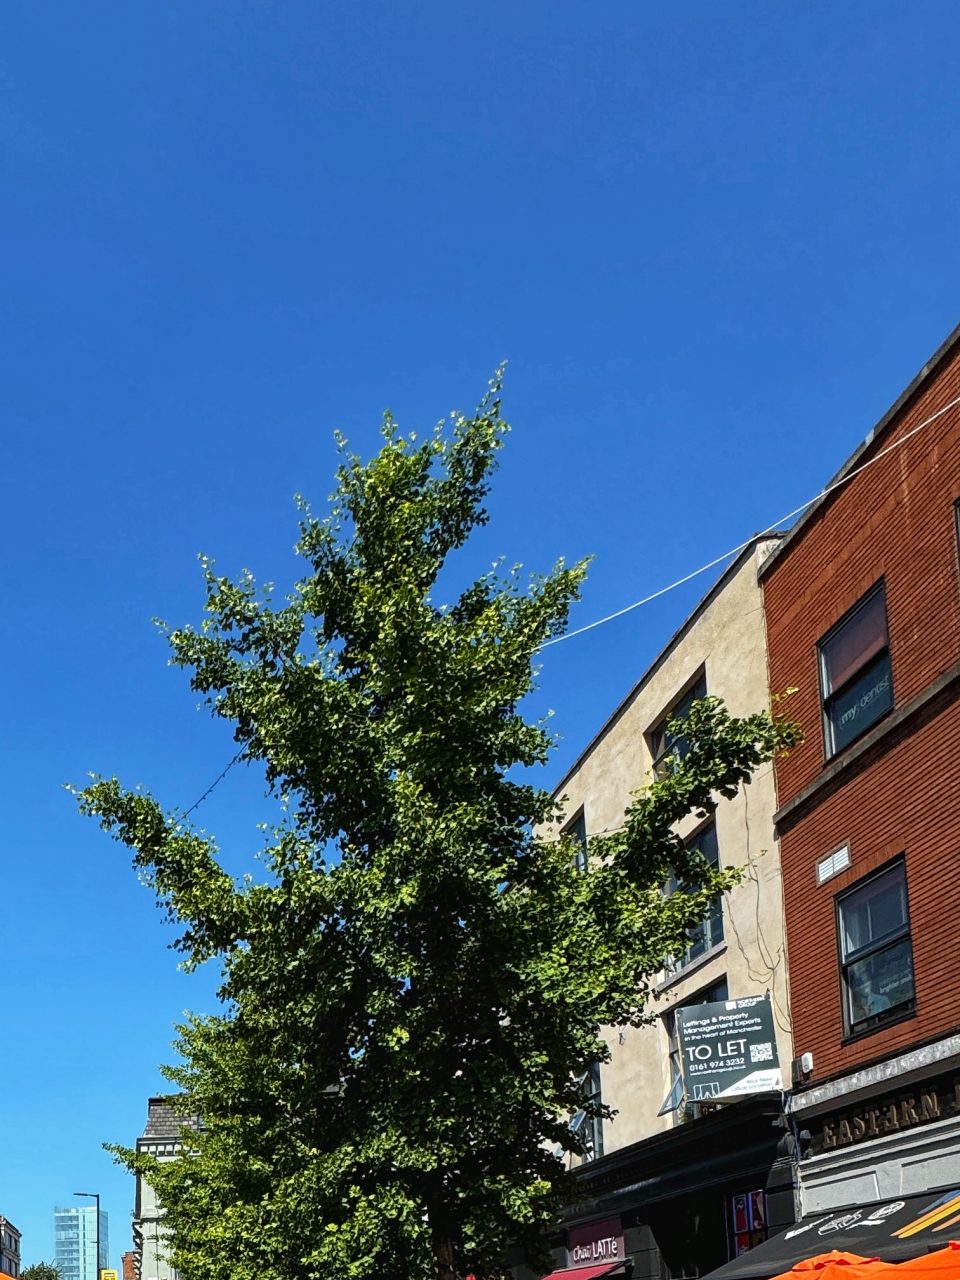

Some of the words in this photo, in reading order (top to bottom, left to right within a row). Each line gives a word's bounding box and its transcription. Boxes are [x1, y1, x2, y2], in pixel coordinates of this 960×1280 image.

[683, 1018, 710, 1028] Lettings
[718, 1012, 749, 1022] Property
[683, 1021, 733, 1034] Management
[735, 1018, 761, 1027] Experts
[726, 1026, 762, 1035] Manchester
[685, 1045, 712, 1061] TO
[717, 1039, 747, 1057] LET
[689, 1062, 707, 1071] 0161
[709, 1060, 724, 1069] 974
[726, 1058, 745, 1066] 3232
[823, 1091, 940, 1148] EASTERN
[573, 1244, 592, 1261] Chai
